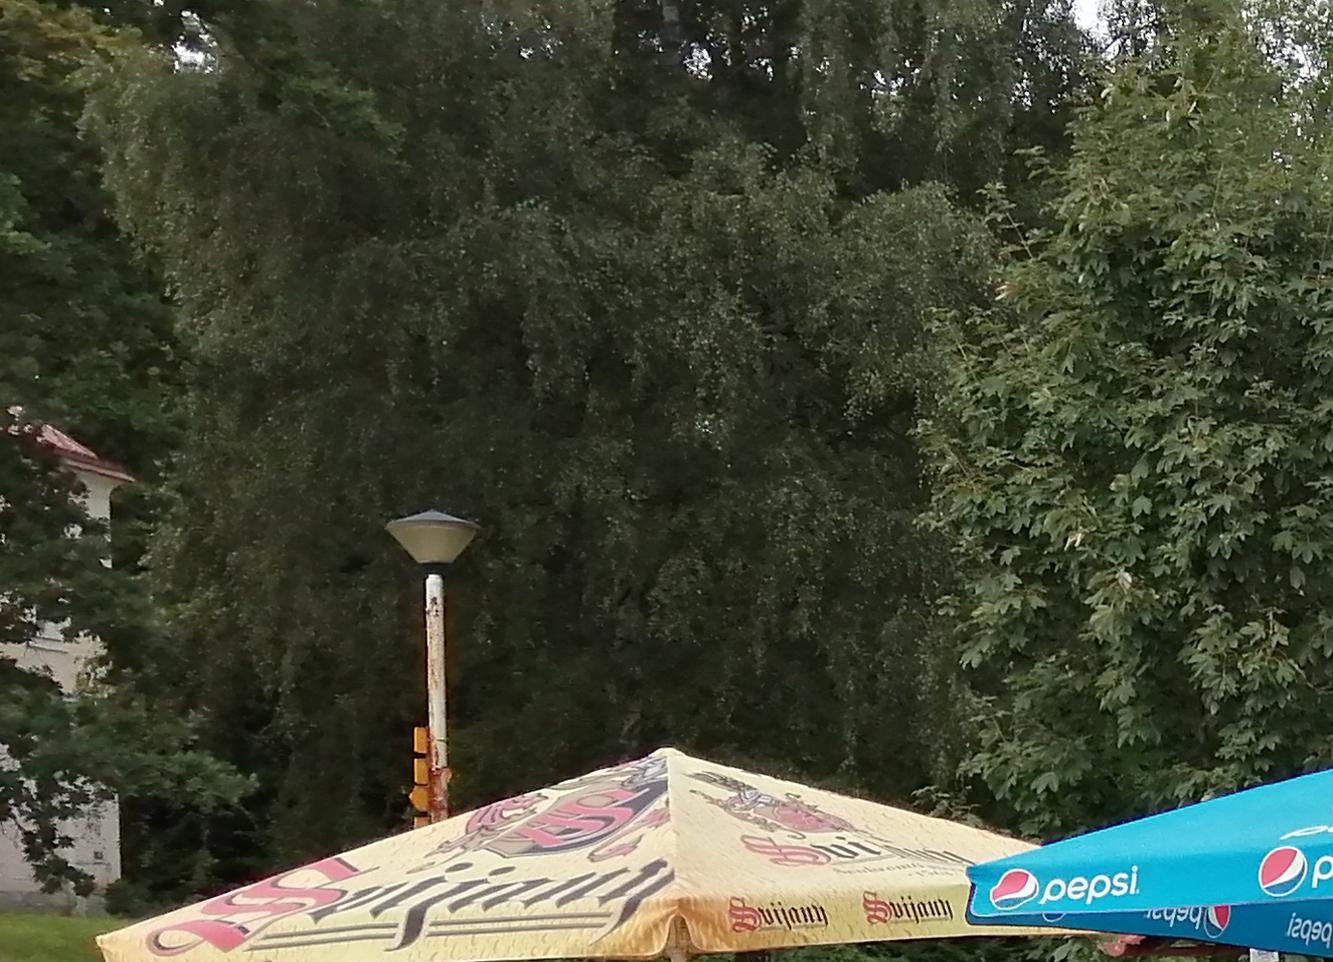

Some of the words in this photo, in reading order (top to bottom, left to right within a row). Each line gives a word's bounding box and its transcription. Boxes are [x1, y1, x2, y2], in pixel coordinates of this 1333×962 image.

[1039, 865, 1140, 905] pepsi
[147, 856, 675, 957] Svijany
[728, 896, 829, 934] Svijany
[862, 891, 954, 925] Svijany
